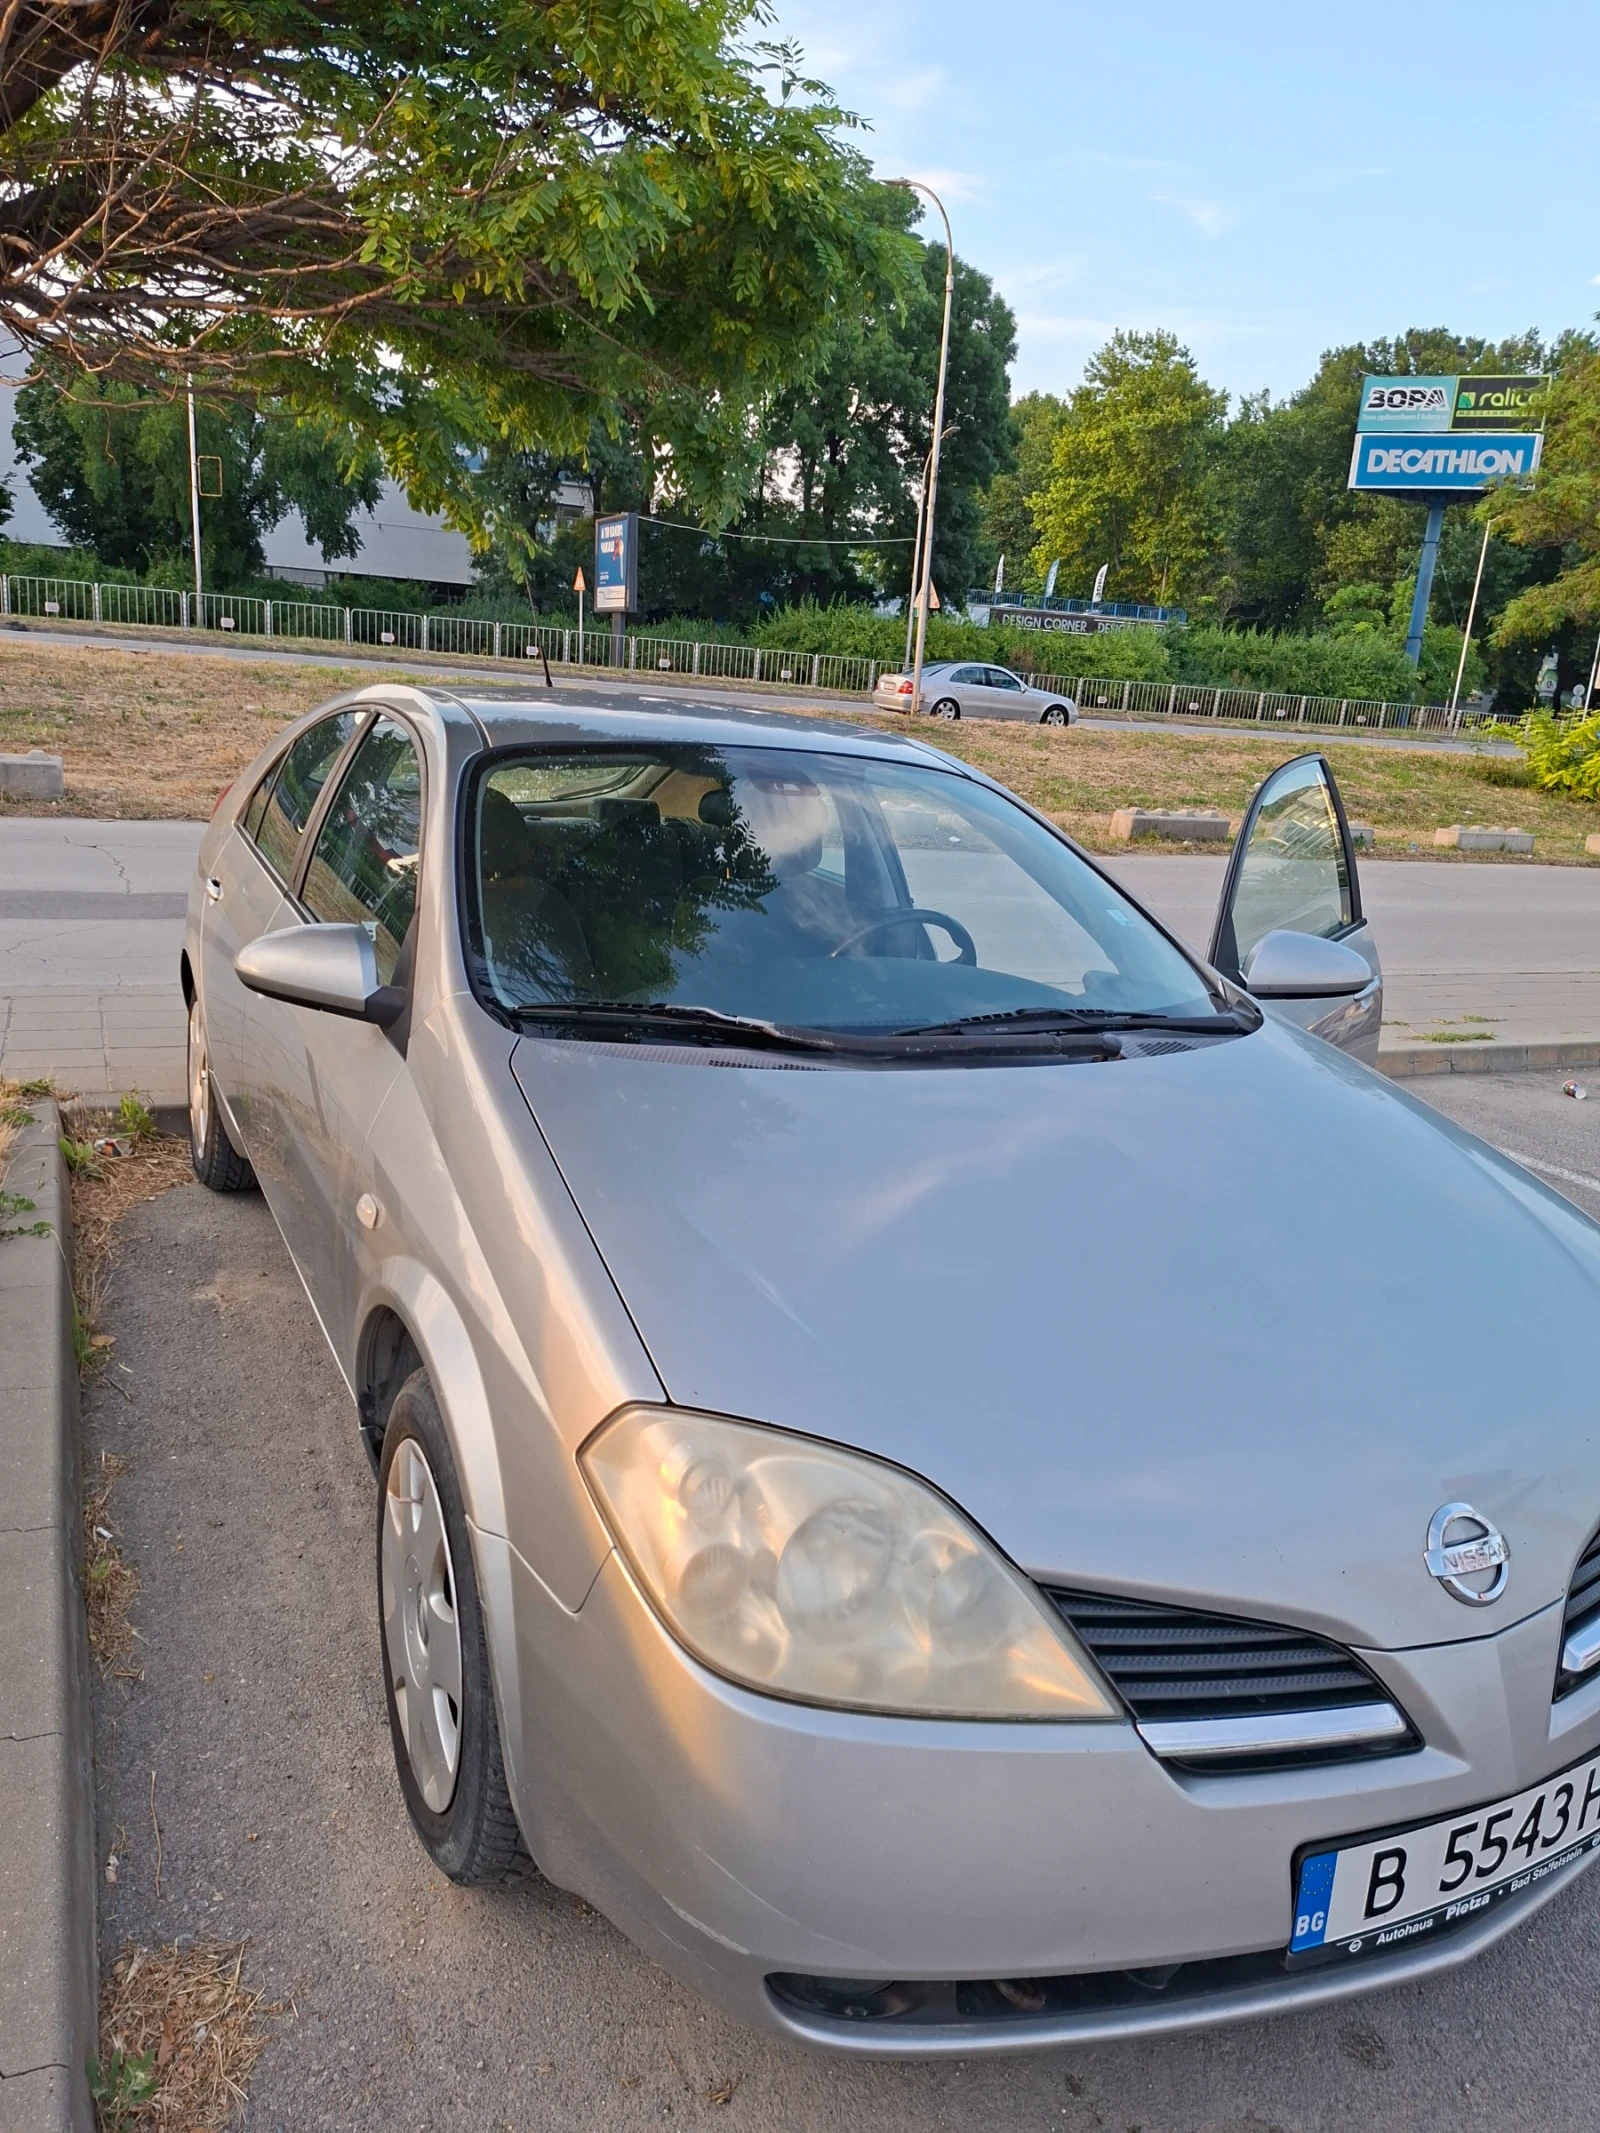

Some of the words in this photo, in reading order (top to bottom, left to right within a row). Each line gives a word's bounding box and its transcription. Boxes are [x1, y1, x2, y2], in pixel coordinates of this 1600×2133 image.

[1365, 387, 1448, 410] ЗОРА
[1367, 449, 1524, 474] DECATHLON
[1002, 614, 1042, 628] DESIGN
[1044, 617, 1087, 632] CORNER
[1441, 1540, 1507, 1571] NISSAN
[1363, 1847, 1408, 1920] B
[1439, 1782, 1574, 1892] 5543
[1376, 1918, 1433, 1945] Autohaus
[1446, 1893, 1491, 1920] Pietza
[1510, 1873, 1530, 1892] Bad
[1295, 1911, 1325, 1937] BG
